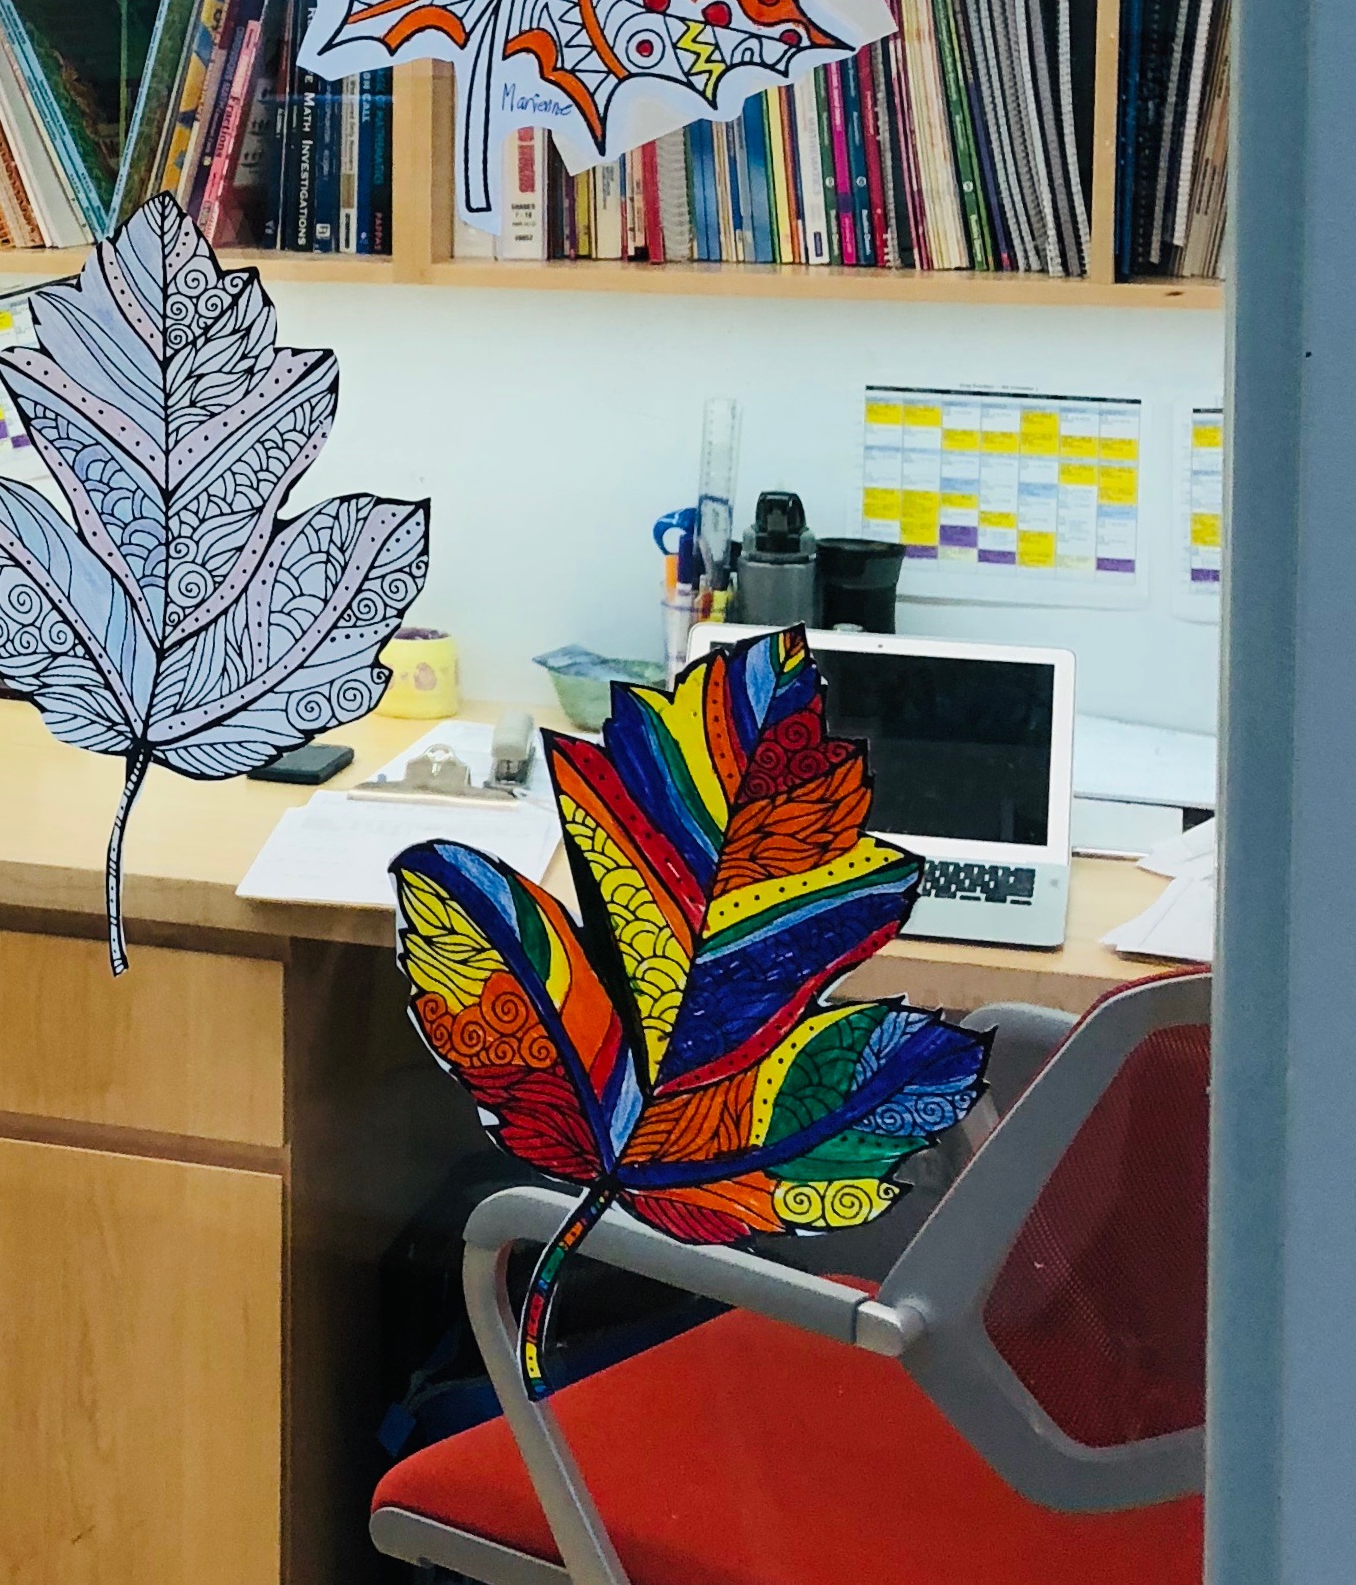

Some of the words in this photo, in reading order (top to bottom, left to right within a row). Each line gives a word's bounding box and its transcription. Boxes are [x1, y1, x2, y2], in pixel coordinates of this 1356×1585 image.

[216, 96, 241, 158] Fractions
[302, 92, 316, 132] MATH
[297, 139, 314, 247] INVESTIGATIONS
